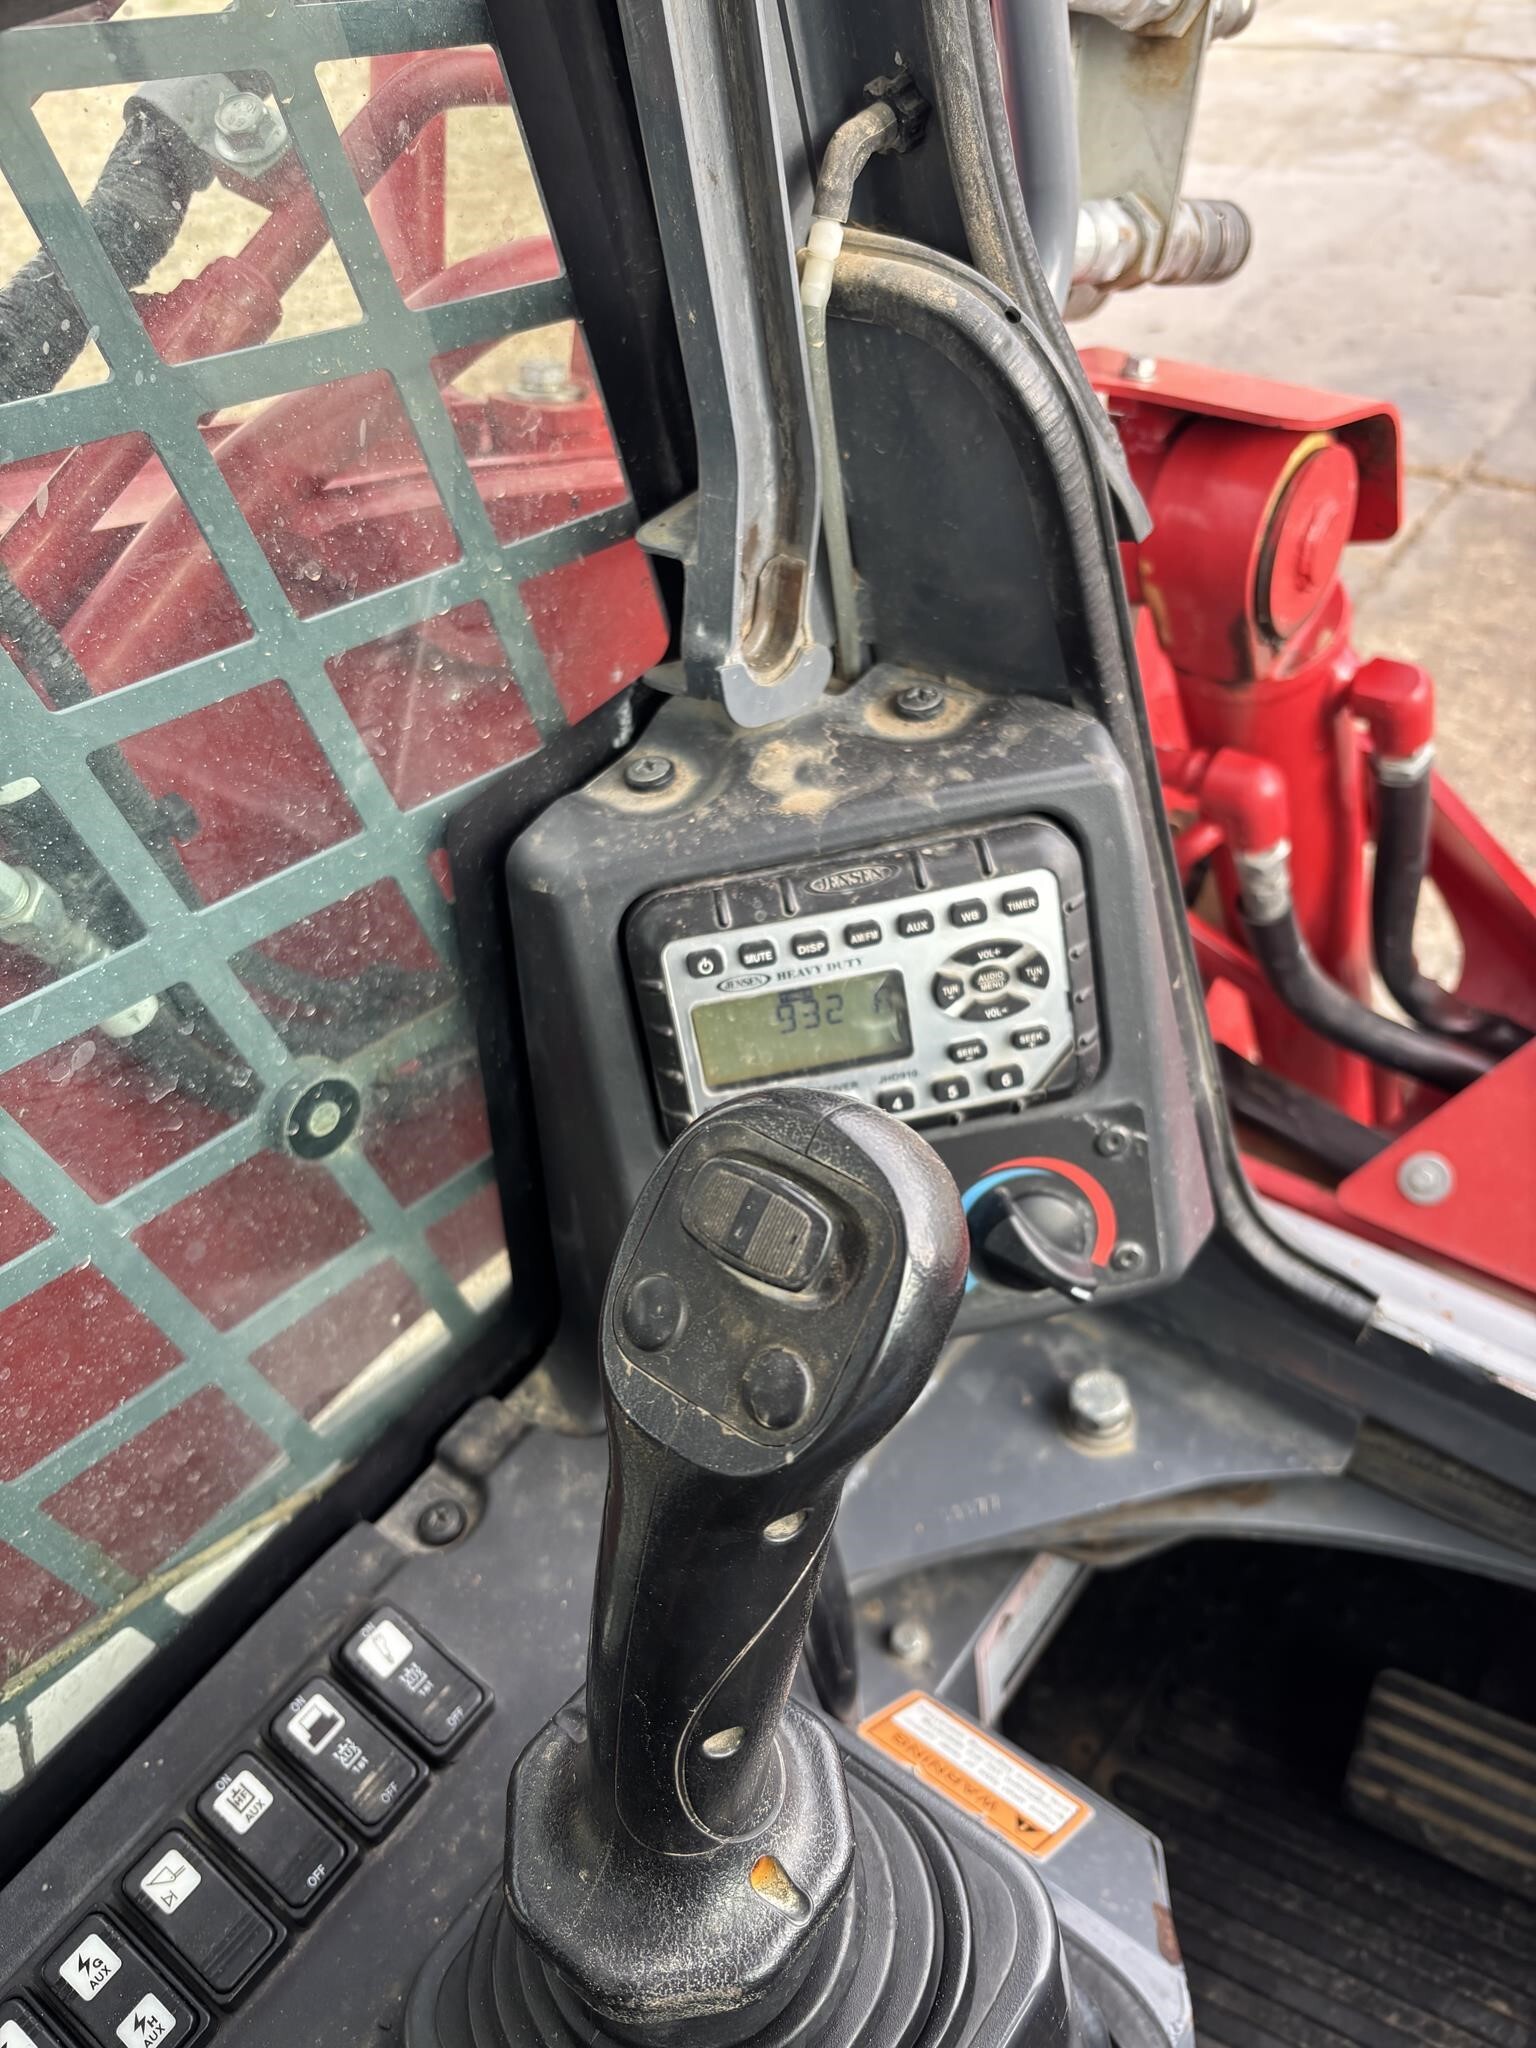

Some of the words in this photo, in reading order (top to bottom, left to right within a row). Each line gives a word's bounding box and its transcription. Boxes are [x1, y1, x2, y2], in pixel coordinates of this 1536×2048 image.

[820, 868, 885, 891] JENSEN
[1006, 899, 1036, 913] TIMER
[960, 910, 980, 923] WB
[906, 920, 929, 934] AUX
[796, 942, 825, 956] DISP
[743, 950, 773, 965] MUTE
[724, 975, 762, 990] JENSEN
[776, 965, 822, 981] HEAVY
[827, 957, 864, 972] DUTY
[977, 970, 1004, 984] AUDIO
[1024, 966, 1043, 977] TUN
[942, 984, 959, 995] TUN
[979, 980, 1005, 992] MENU
[1001, 1072, 1013, 1087] 6
[947, 1084, 959, 1099] 5
[892, 1096, 904, 1111] 4
[360, 1621, 376, 1638] ON
[289, 1694, 306, 1712] ON
[446, 1705, 464, 1728] OFF
[215, 1773, 232, 1791] ON
[380, 1781, 399, 1804] OFF
[244, 1798, 266, 1823] AUX
[306, 1863, 326, 1887] OFF
[92, 1957, 104, 1968] G
[89, 1966, 112, 1991] AUX
[147, 2015, 159, 2028] H
[144, 2023, 166, 2048] AUX
